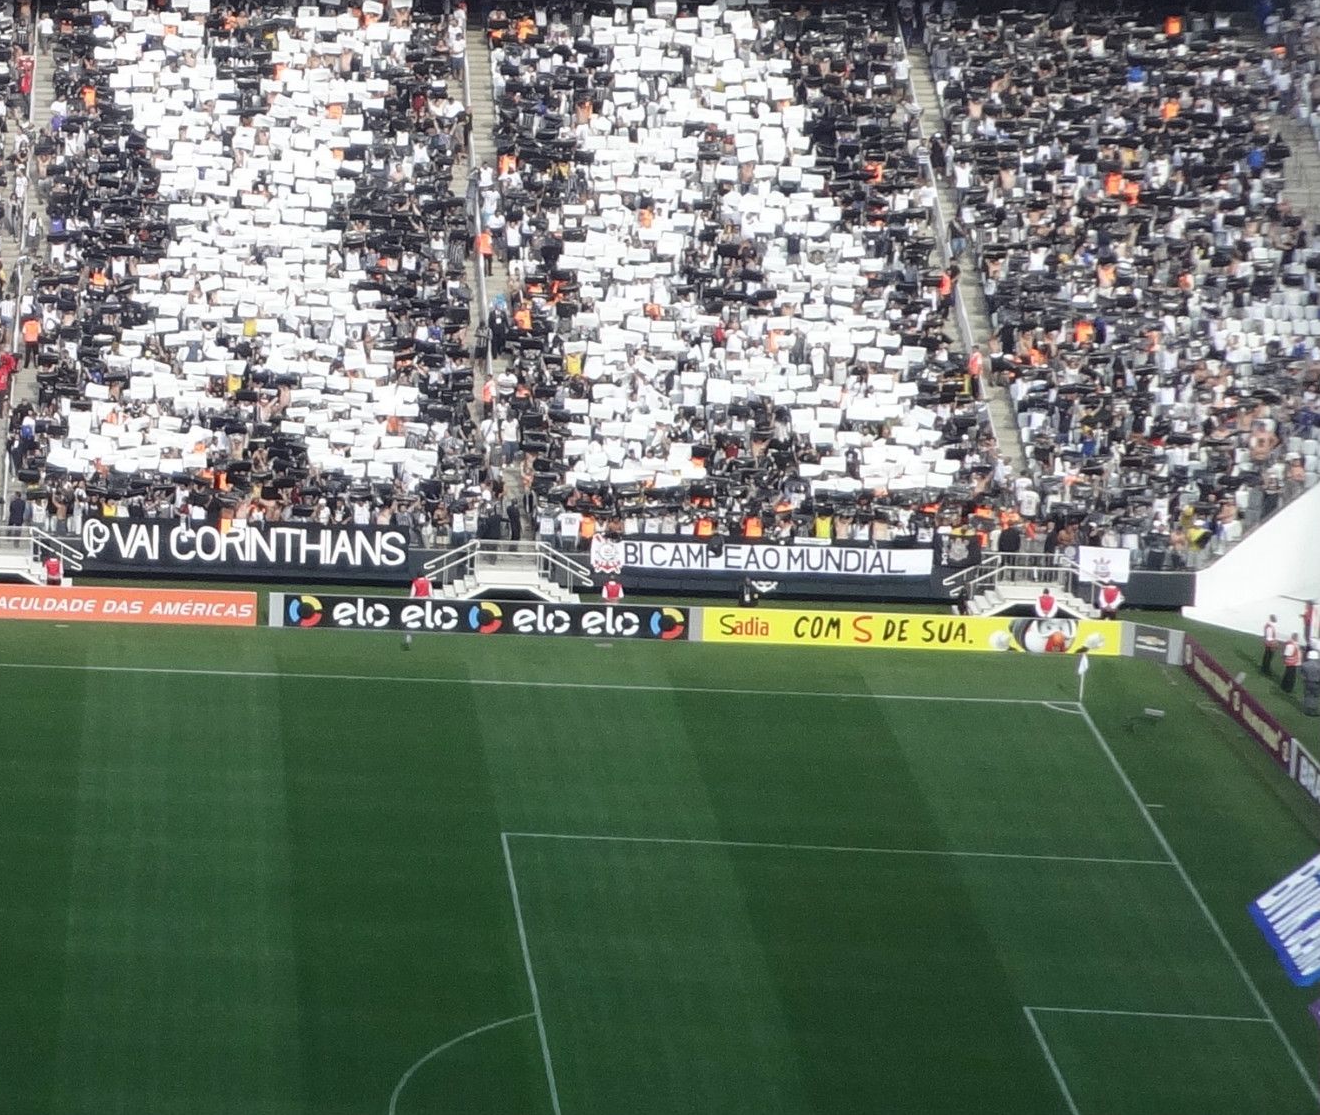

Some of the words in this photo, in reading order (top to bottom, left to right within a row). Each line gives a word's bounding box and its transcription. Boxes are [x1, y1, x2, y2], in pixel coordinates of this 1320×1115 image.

[113, 523, 158, 559] VAI
[170, 526, 407, 566] CORINTHIANS
[788, 547, 907, 573] MUNDIAL
[103, 600, 143, 614] DAS
[151, 597, 254, 618] AMÉRICAS
[333, 599, 390, 627] elo
[401, 602, 459, 629] elo
[513, 605, 571, 633] elo
[582, 608, 640, 635] elo
[720, 614, 769, 636] Sadia
[794, 616, 841, 638] COM
[853, 616, 873, 643] S
[883, 620, 910, 640] DE
[921, 621, 974, 644] SUA.
